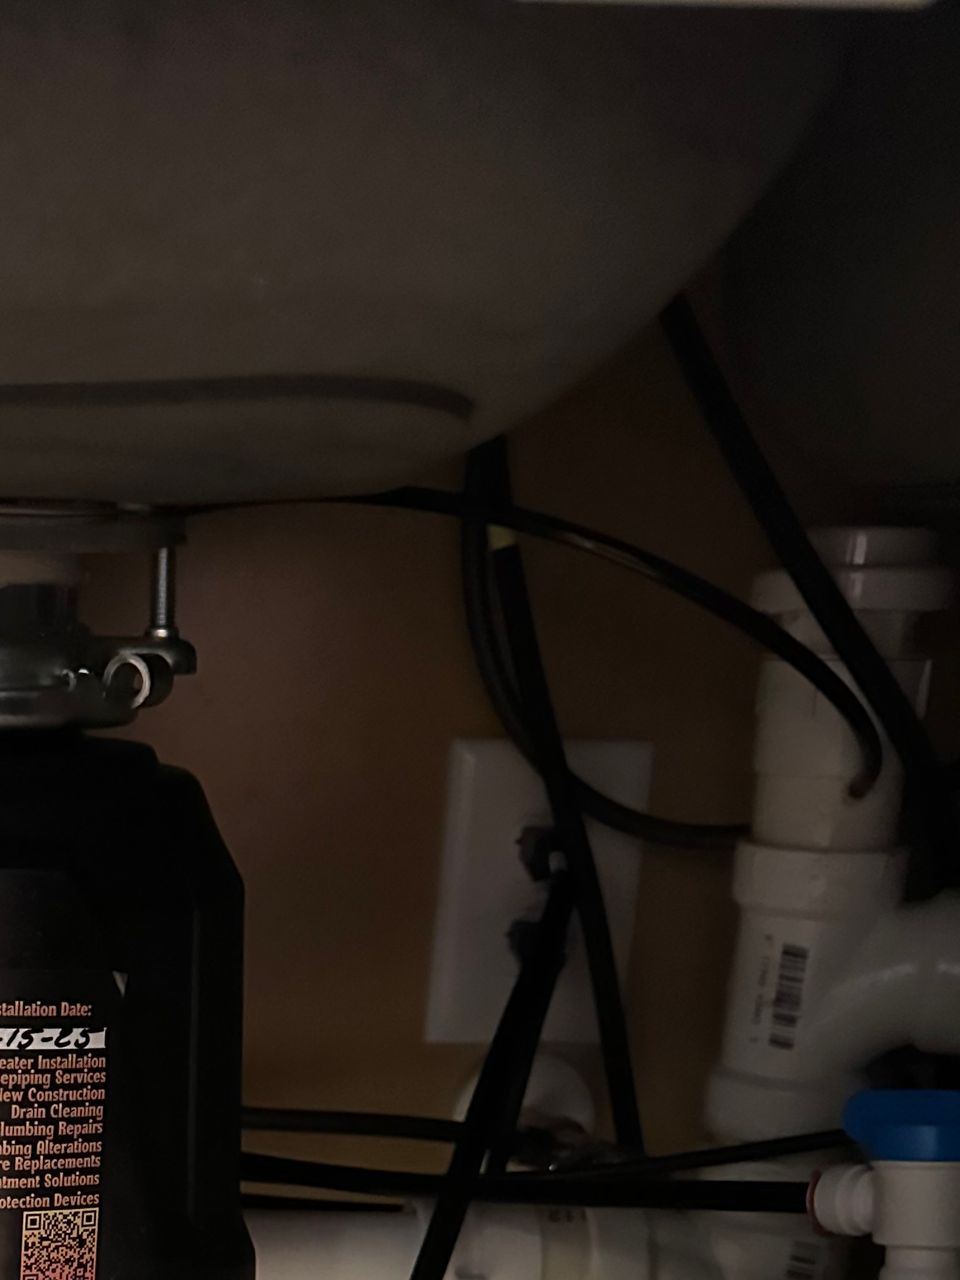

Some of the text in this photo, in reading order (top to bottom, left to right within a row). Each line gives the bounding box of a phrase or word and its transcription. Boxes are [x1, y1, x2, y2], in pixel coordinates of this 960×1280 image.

[60, 1001, 92, 1017] Date:
[37, 1052, 106, 1069] Installation
[55, 1068, 106, 1085] Services
[27, 1085, 106, 1102] Construction
[11, 1101, 104, 1120] Drain Cleaning
[58, 1118, 103, 1138] Repairs
[36, 1138, 103, 1155] Alterations
[14, 1154, 101, 1174] Replacements
[44, 1171, 100, 1188] Solutions
[54, 1190, 100, 1207] Devices
